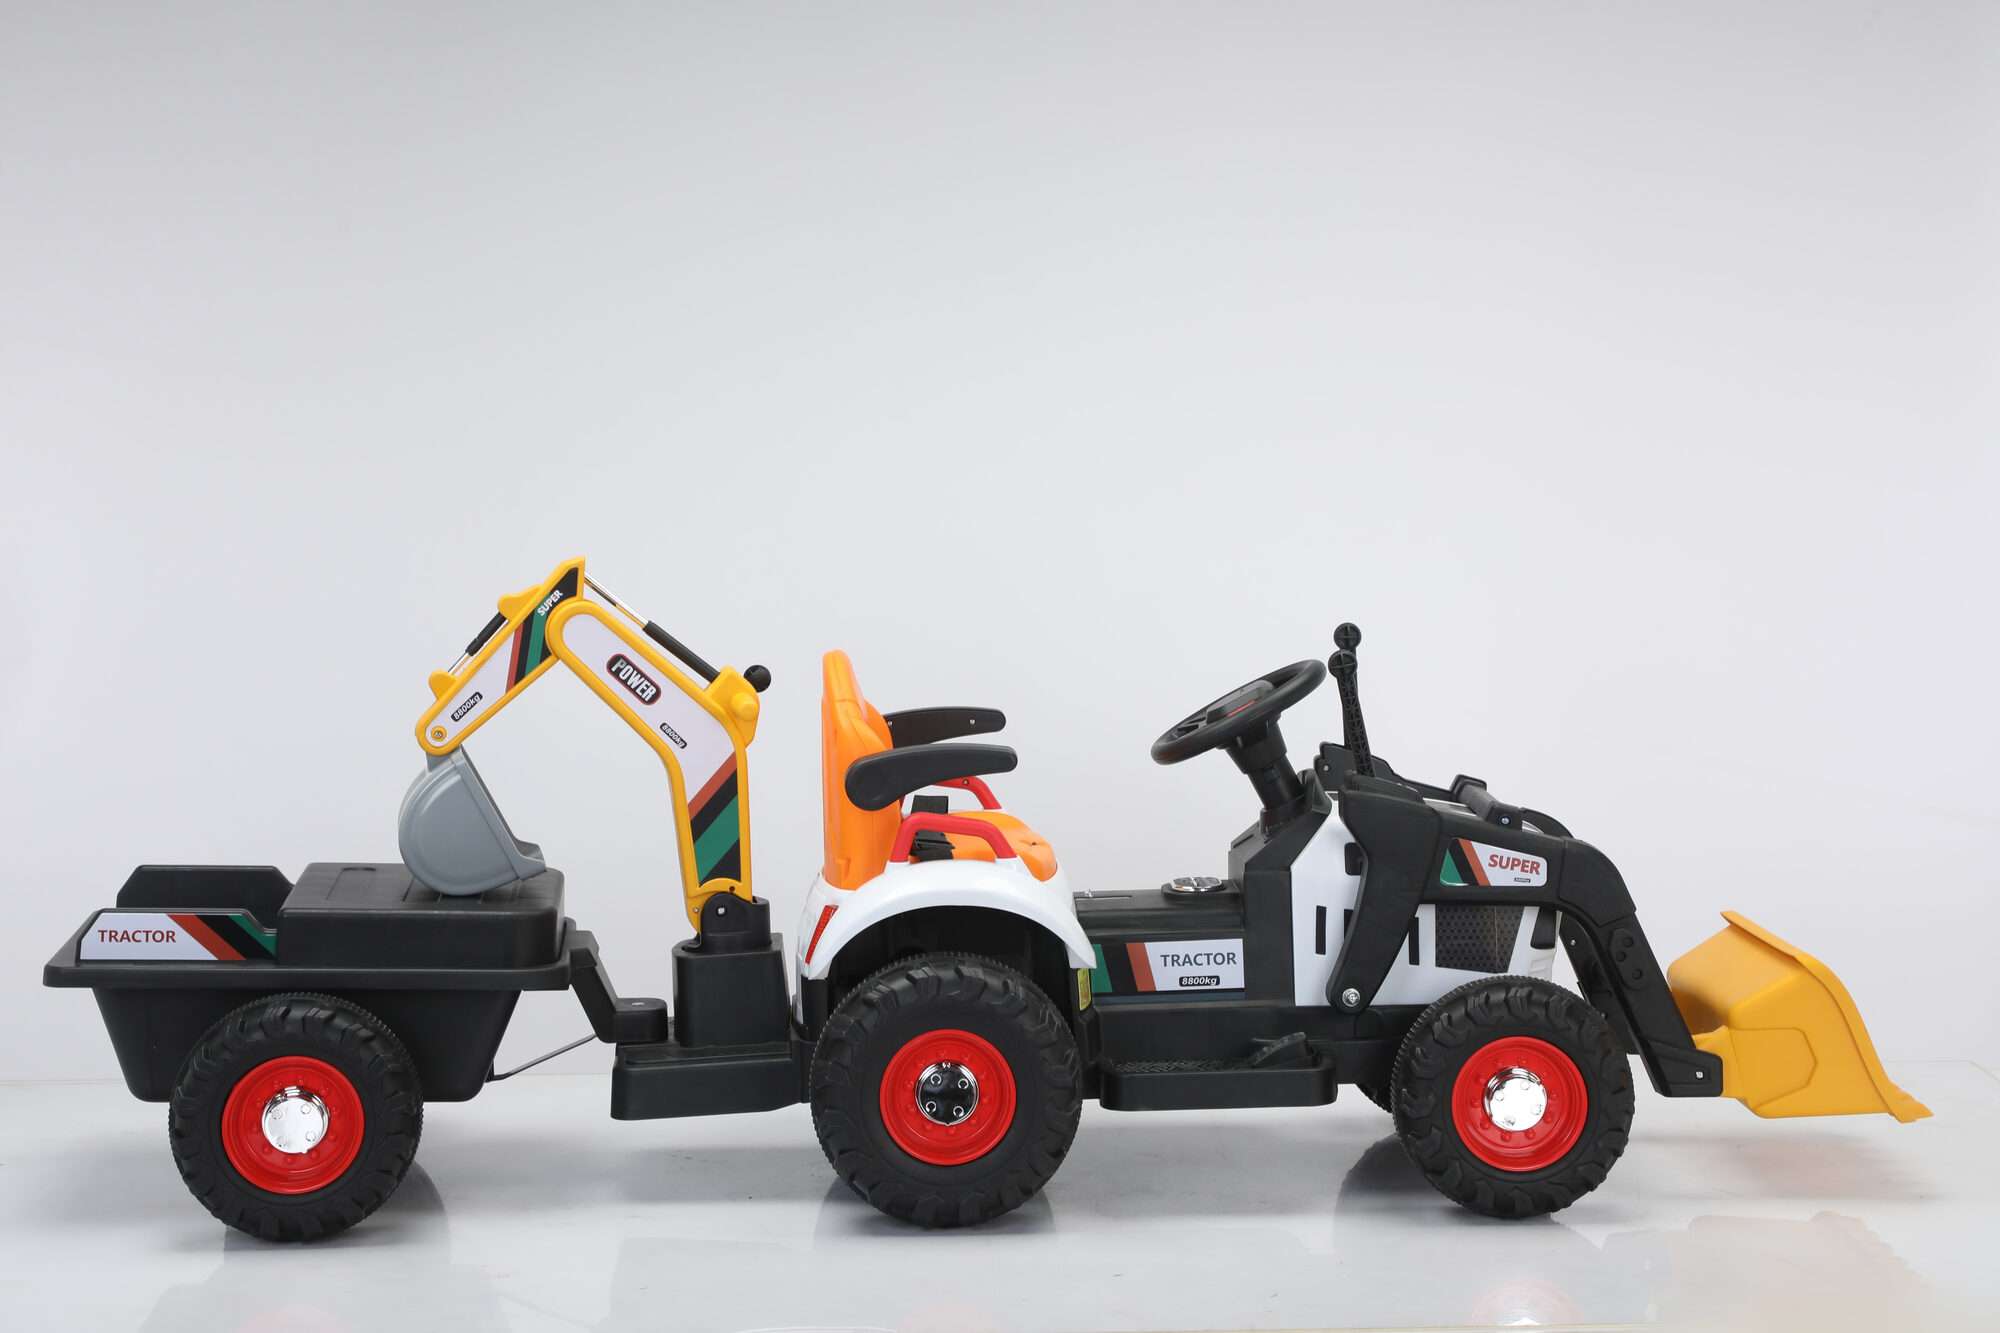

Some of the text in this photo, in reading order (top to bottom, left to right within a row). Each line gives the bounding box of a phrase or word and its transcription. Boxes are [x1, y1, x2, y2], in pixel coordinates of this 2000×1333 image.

[537, 589, 563, 617] SUPER
[611, 658, 657, 702] POWER
[453, 694, 481, 720] 8800kg
[1488, 853, 1541, 875] SUPER
[97, 929, 177, 943] TRACTOR
[1160, 951, 1238, 968] TRACTOR
[1181, 975, 1218, 986] 8800kg
